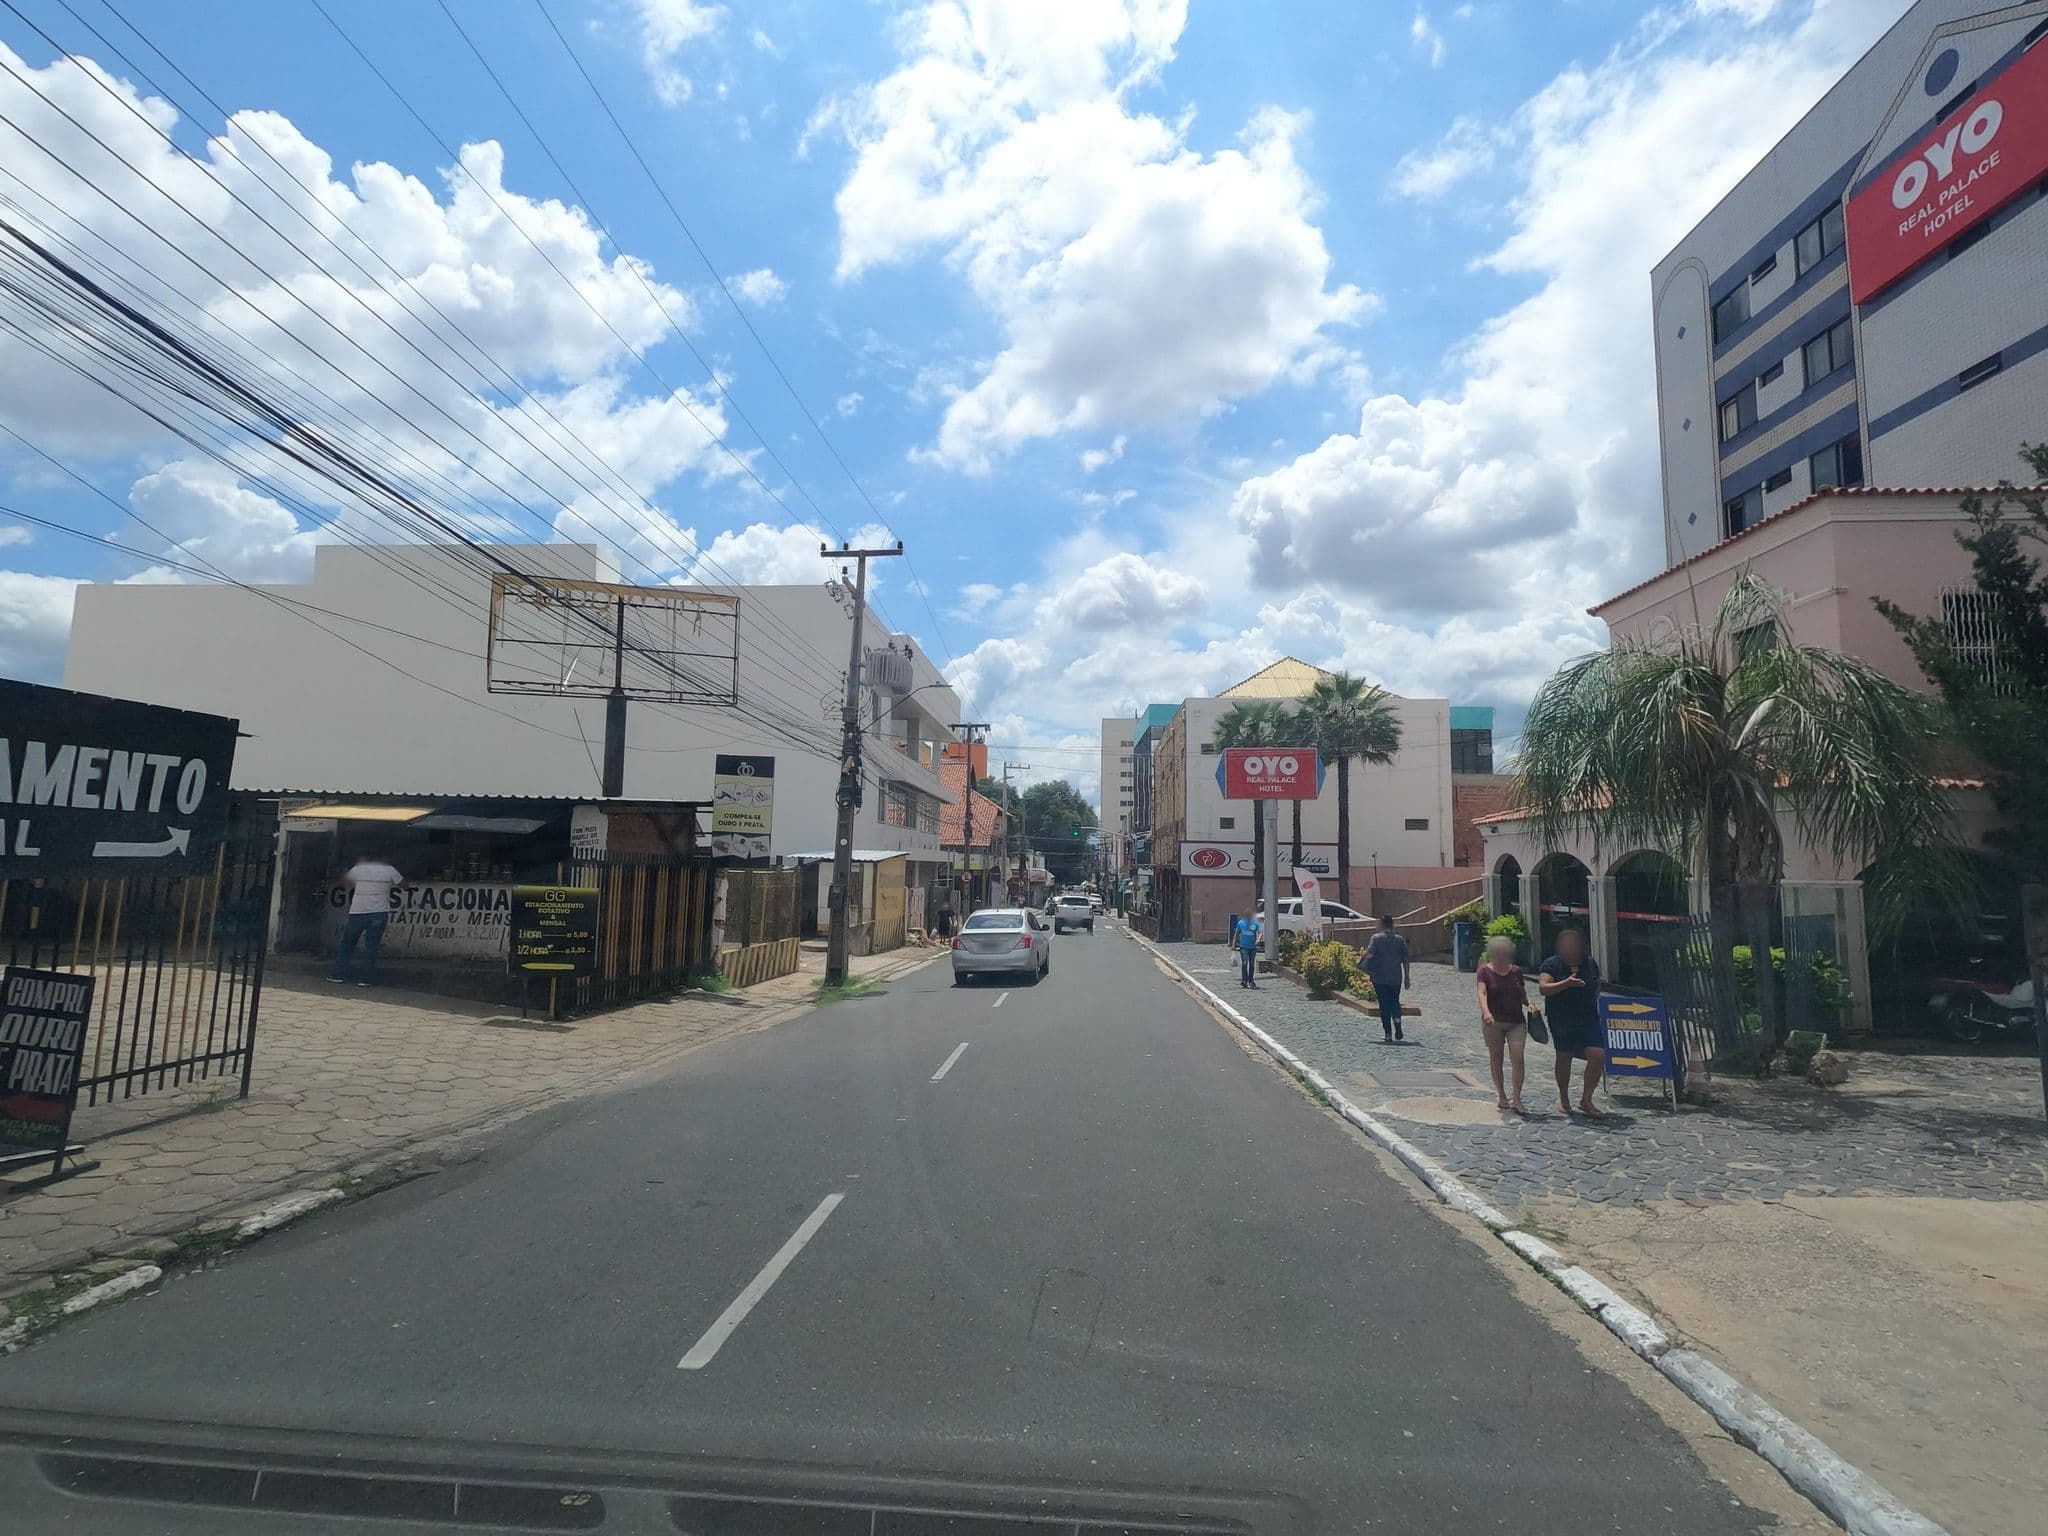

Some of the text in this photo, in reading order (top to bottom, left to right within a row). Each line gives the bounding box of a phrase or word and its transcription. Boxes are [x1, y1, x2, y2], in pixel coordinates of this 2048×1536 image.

[1891, 99, 2003, 210] OYO
[1899, 149, 2001, 237] REAL PALACE
[1924, 194, 1974, 237] HOTEL
[1244, 756, 1299, 776] OYO
[0, 818, 41, 857] L
[330, 886, 354, 908] G
[545, 890, 566, 901] GG
[0, 1013, 82, 1051] OURO
[1608, 1029, 1664, 1051] ROTATIVO
